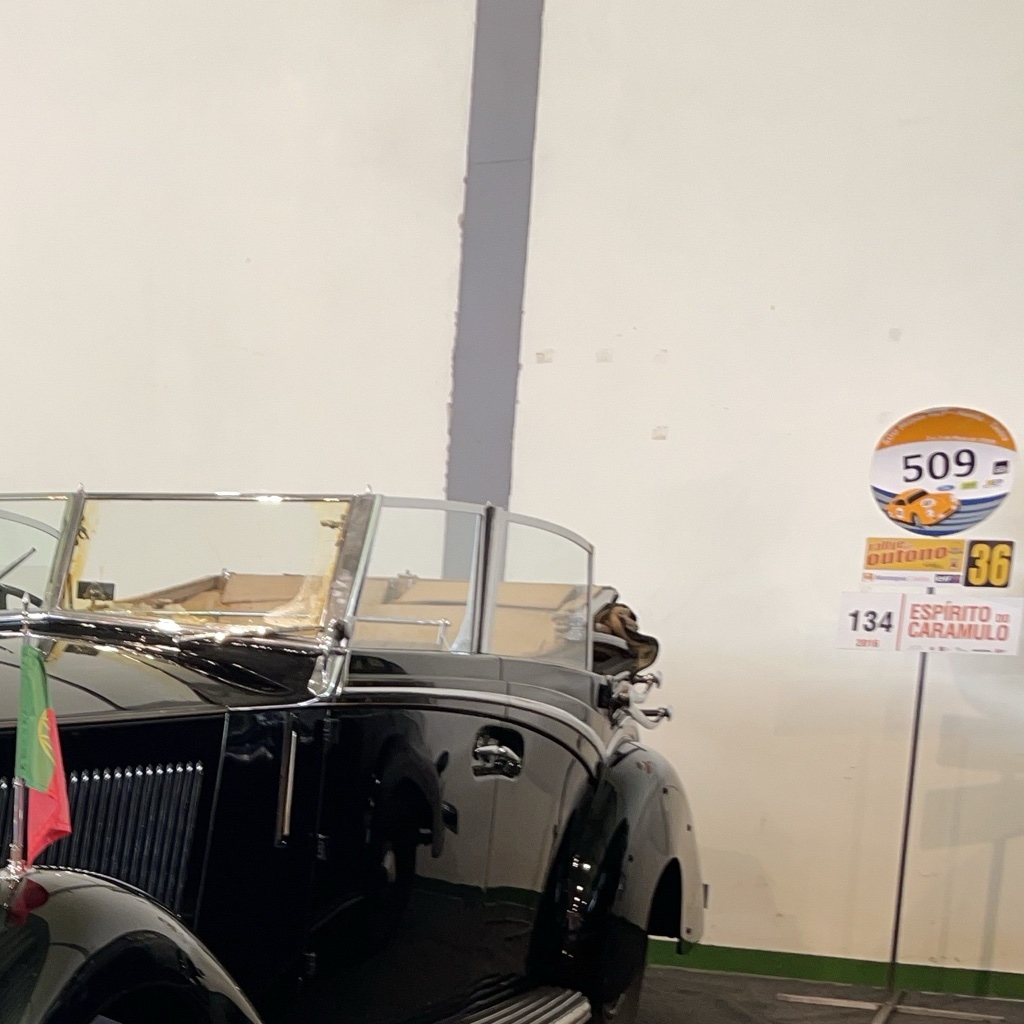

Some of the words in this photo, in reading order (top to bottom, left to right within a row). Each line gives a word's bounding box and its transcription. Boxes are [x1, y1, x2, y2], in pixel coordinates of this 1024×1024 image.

[902, 448, 976, 483] 509
[866, 546, 948, 566] outono
[967, 543, 1012, 586] 36
[848, 609, 894, 633] 134
[909, 602, 992, 623] ESPÍRITO
[907, 621, 1010, 641] CARAMULO
